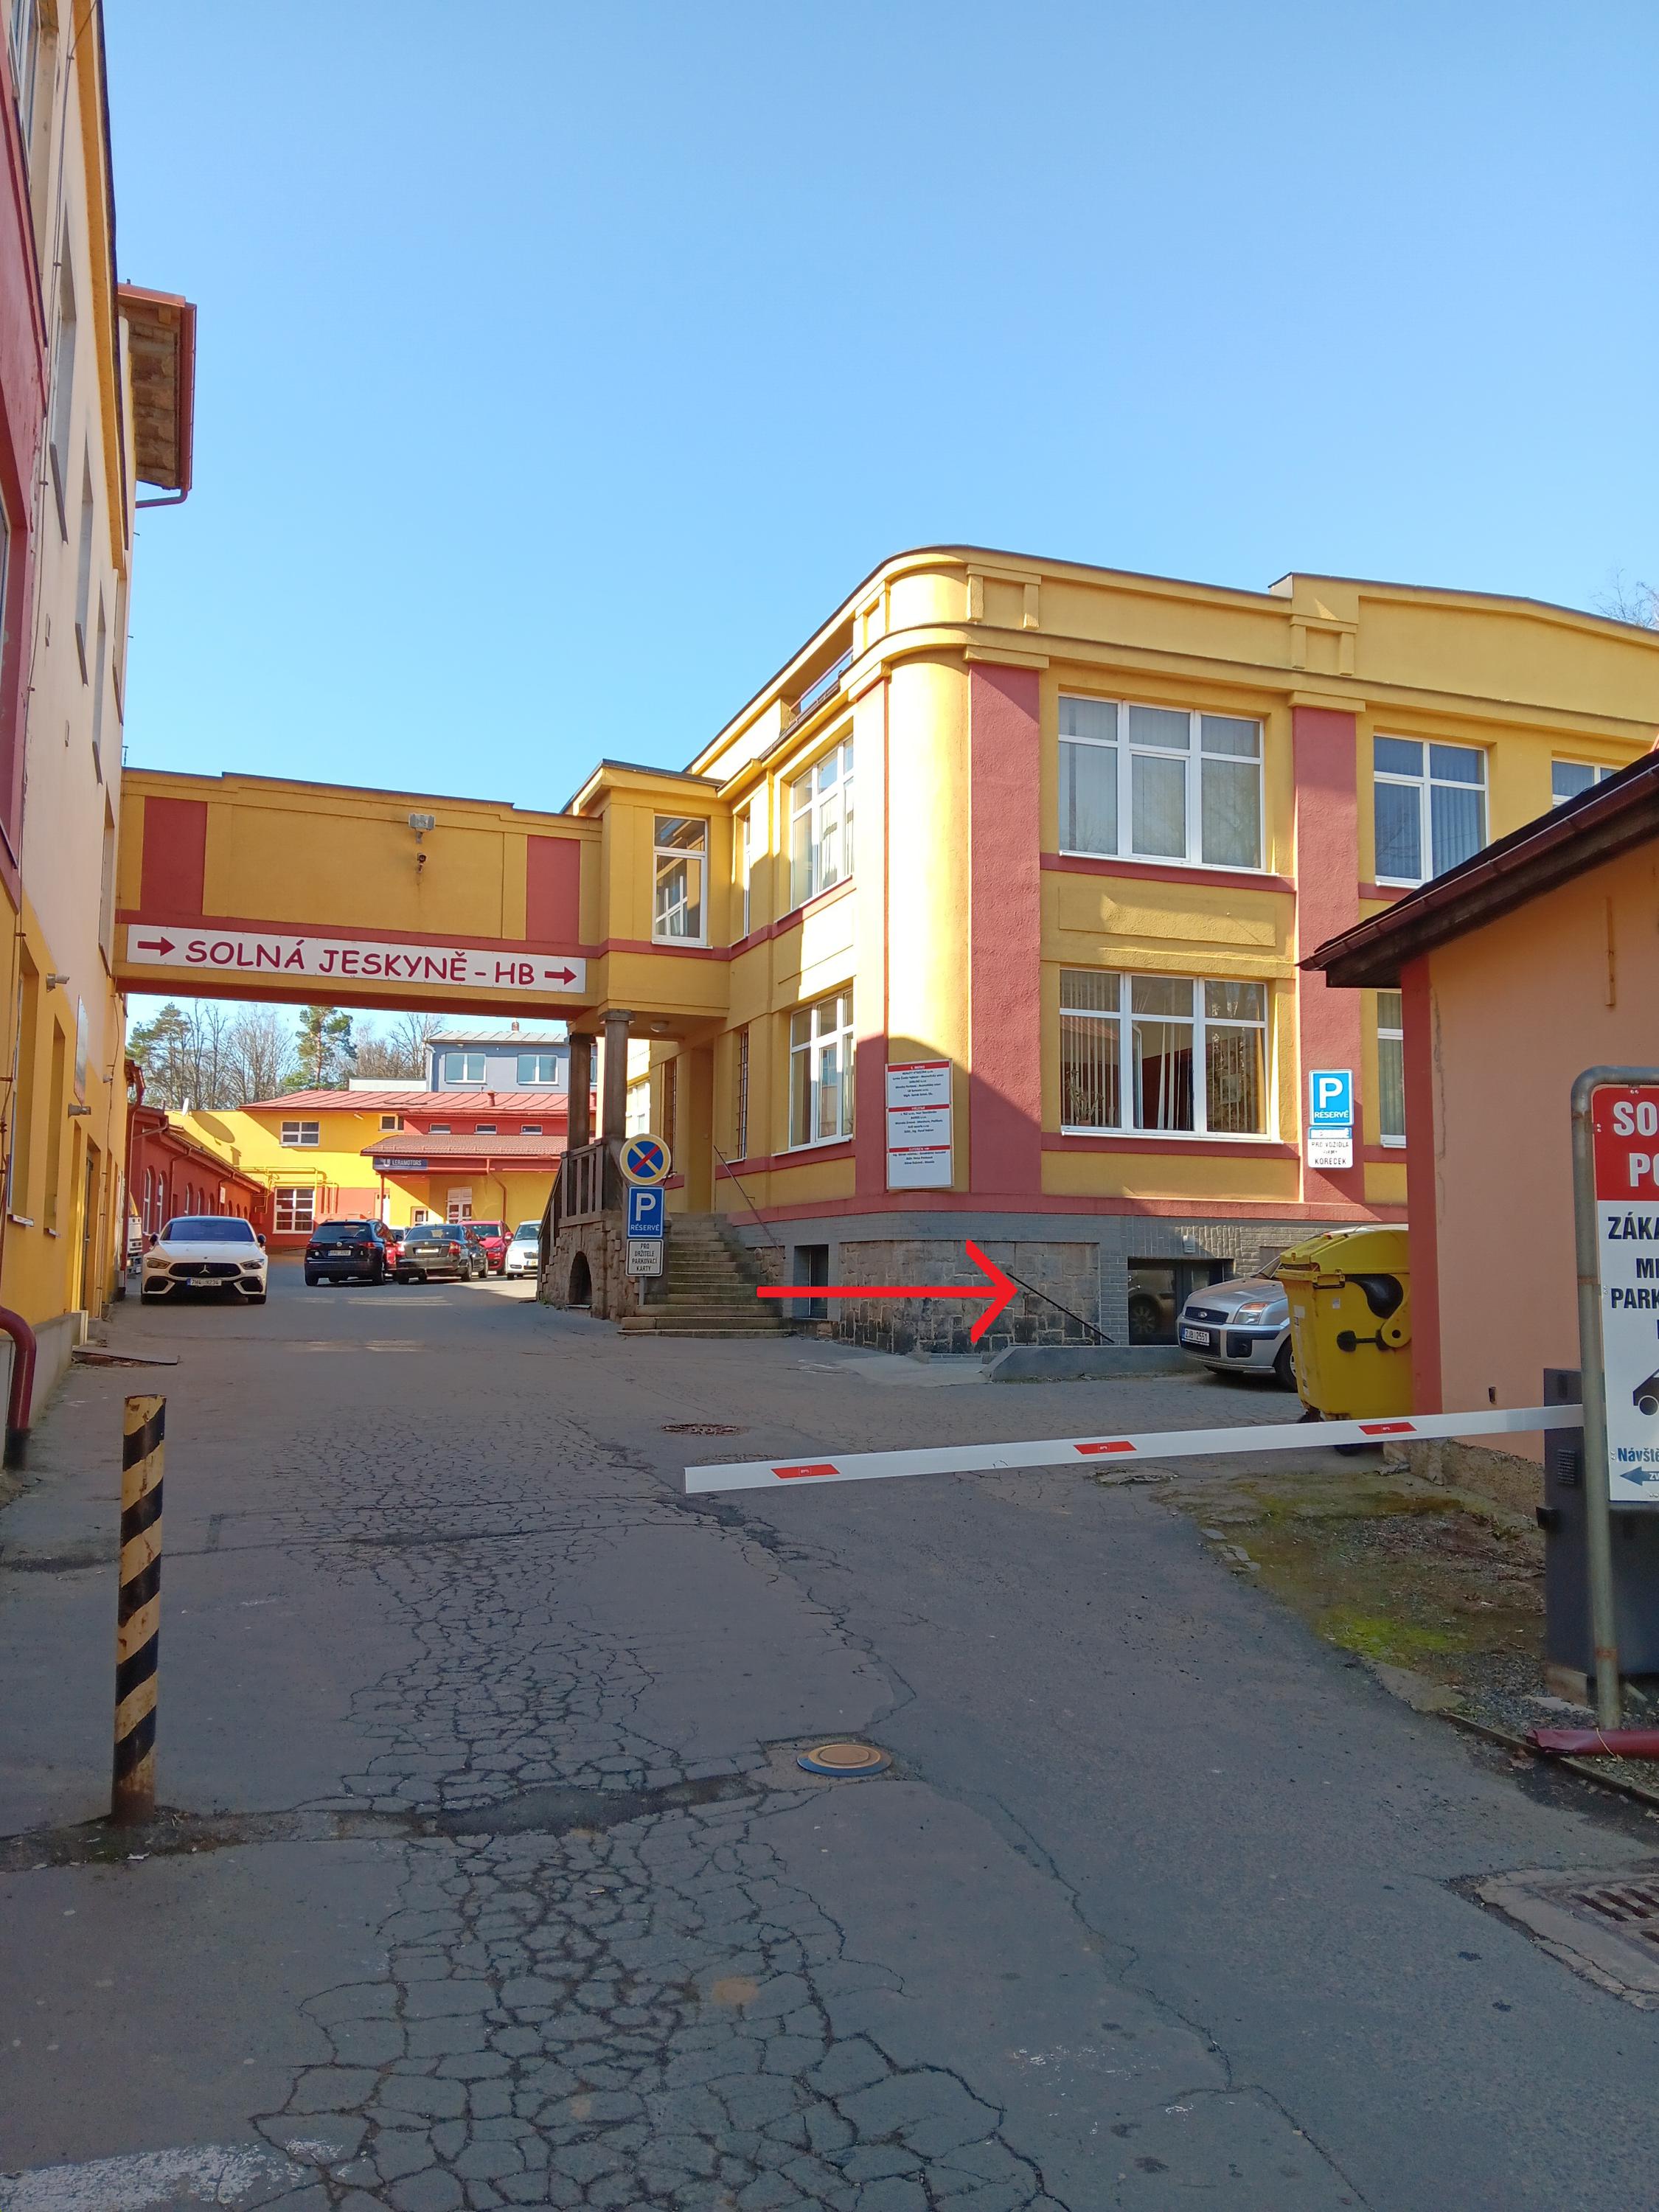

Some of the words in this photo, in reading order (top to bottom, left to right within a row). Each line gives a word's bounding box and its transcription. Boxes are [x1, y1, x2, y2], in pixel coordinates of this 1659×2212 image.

[185, 939, 305, 970] SOLNÁ
[319, 949, 467, 981] JESKYNĚ
[495, 961, 535, 985] HB
[1319, 1077, 1343, 1109] P
[1314, 1110, 1349, 1119] RÉSERVÉ
[636, 1192, 656, 1221] P
[630, 1223, 660, 1231] RÉSERVÉ
